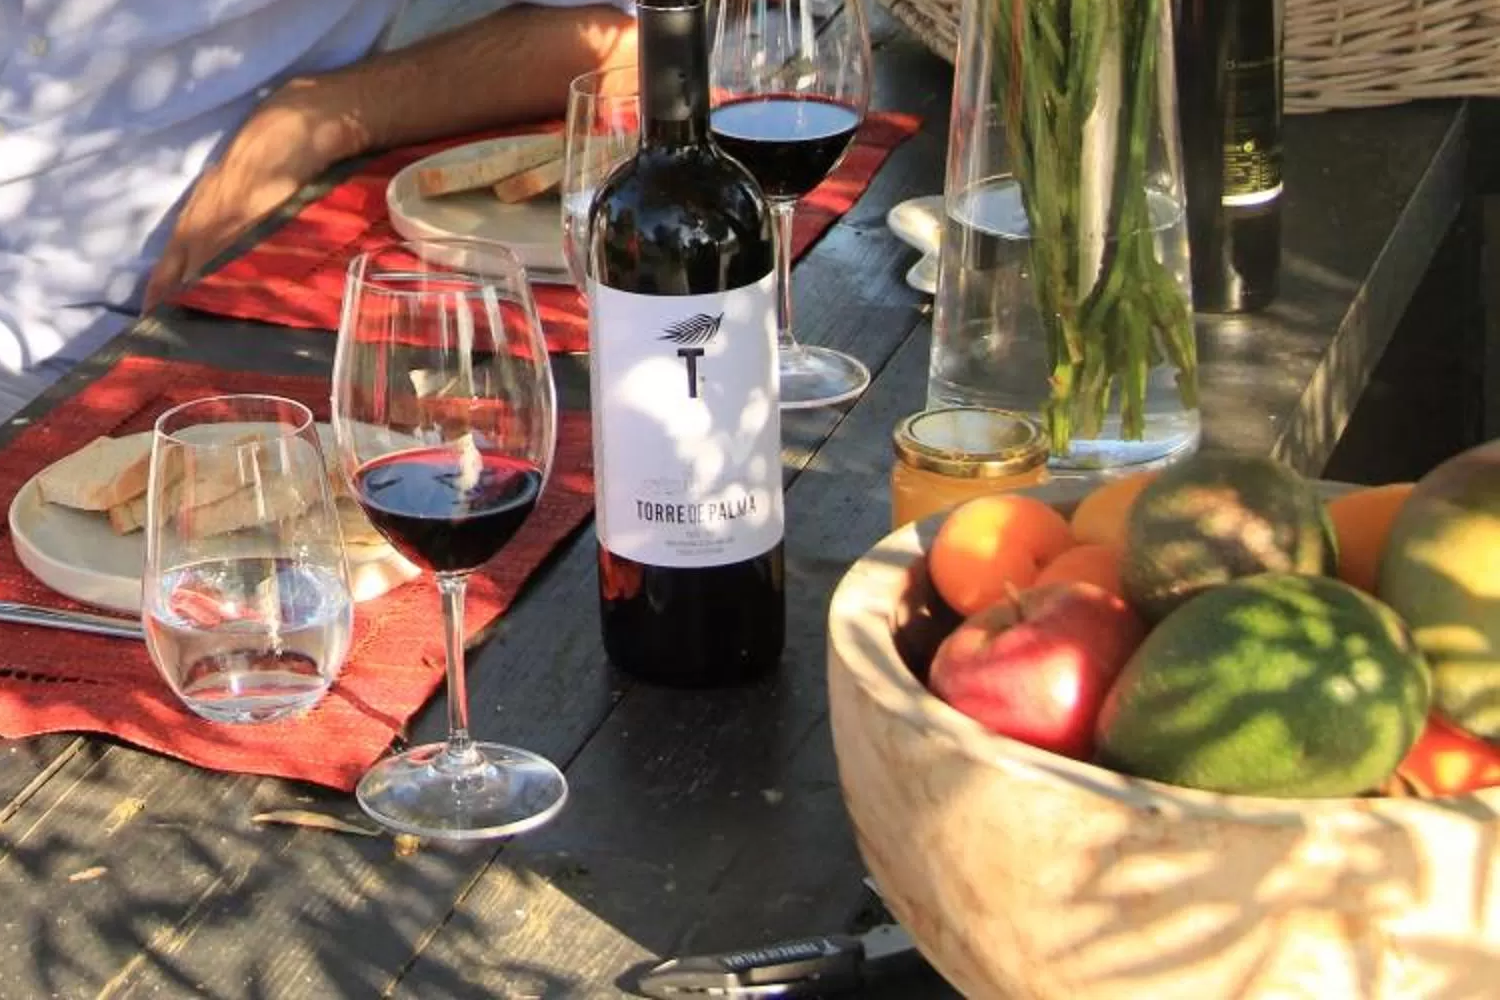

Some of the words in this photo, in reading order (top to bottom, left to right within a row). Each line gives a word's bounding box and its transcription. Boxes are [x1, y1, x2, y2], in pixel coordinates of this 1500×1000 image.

[677, 347, 705, 399] T
[636, 499, 686, 525] TORRE
[687, 503, 705, 525] DE
[708, 495, 757, 522] PALMA
